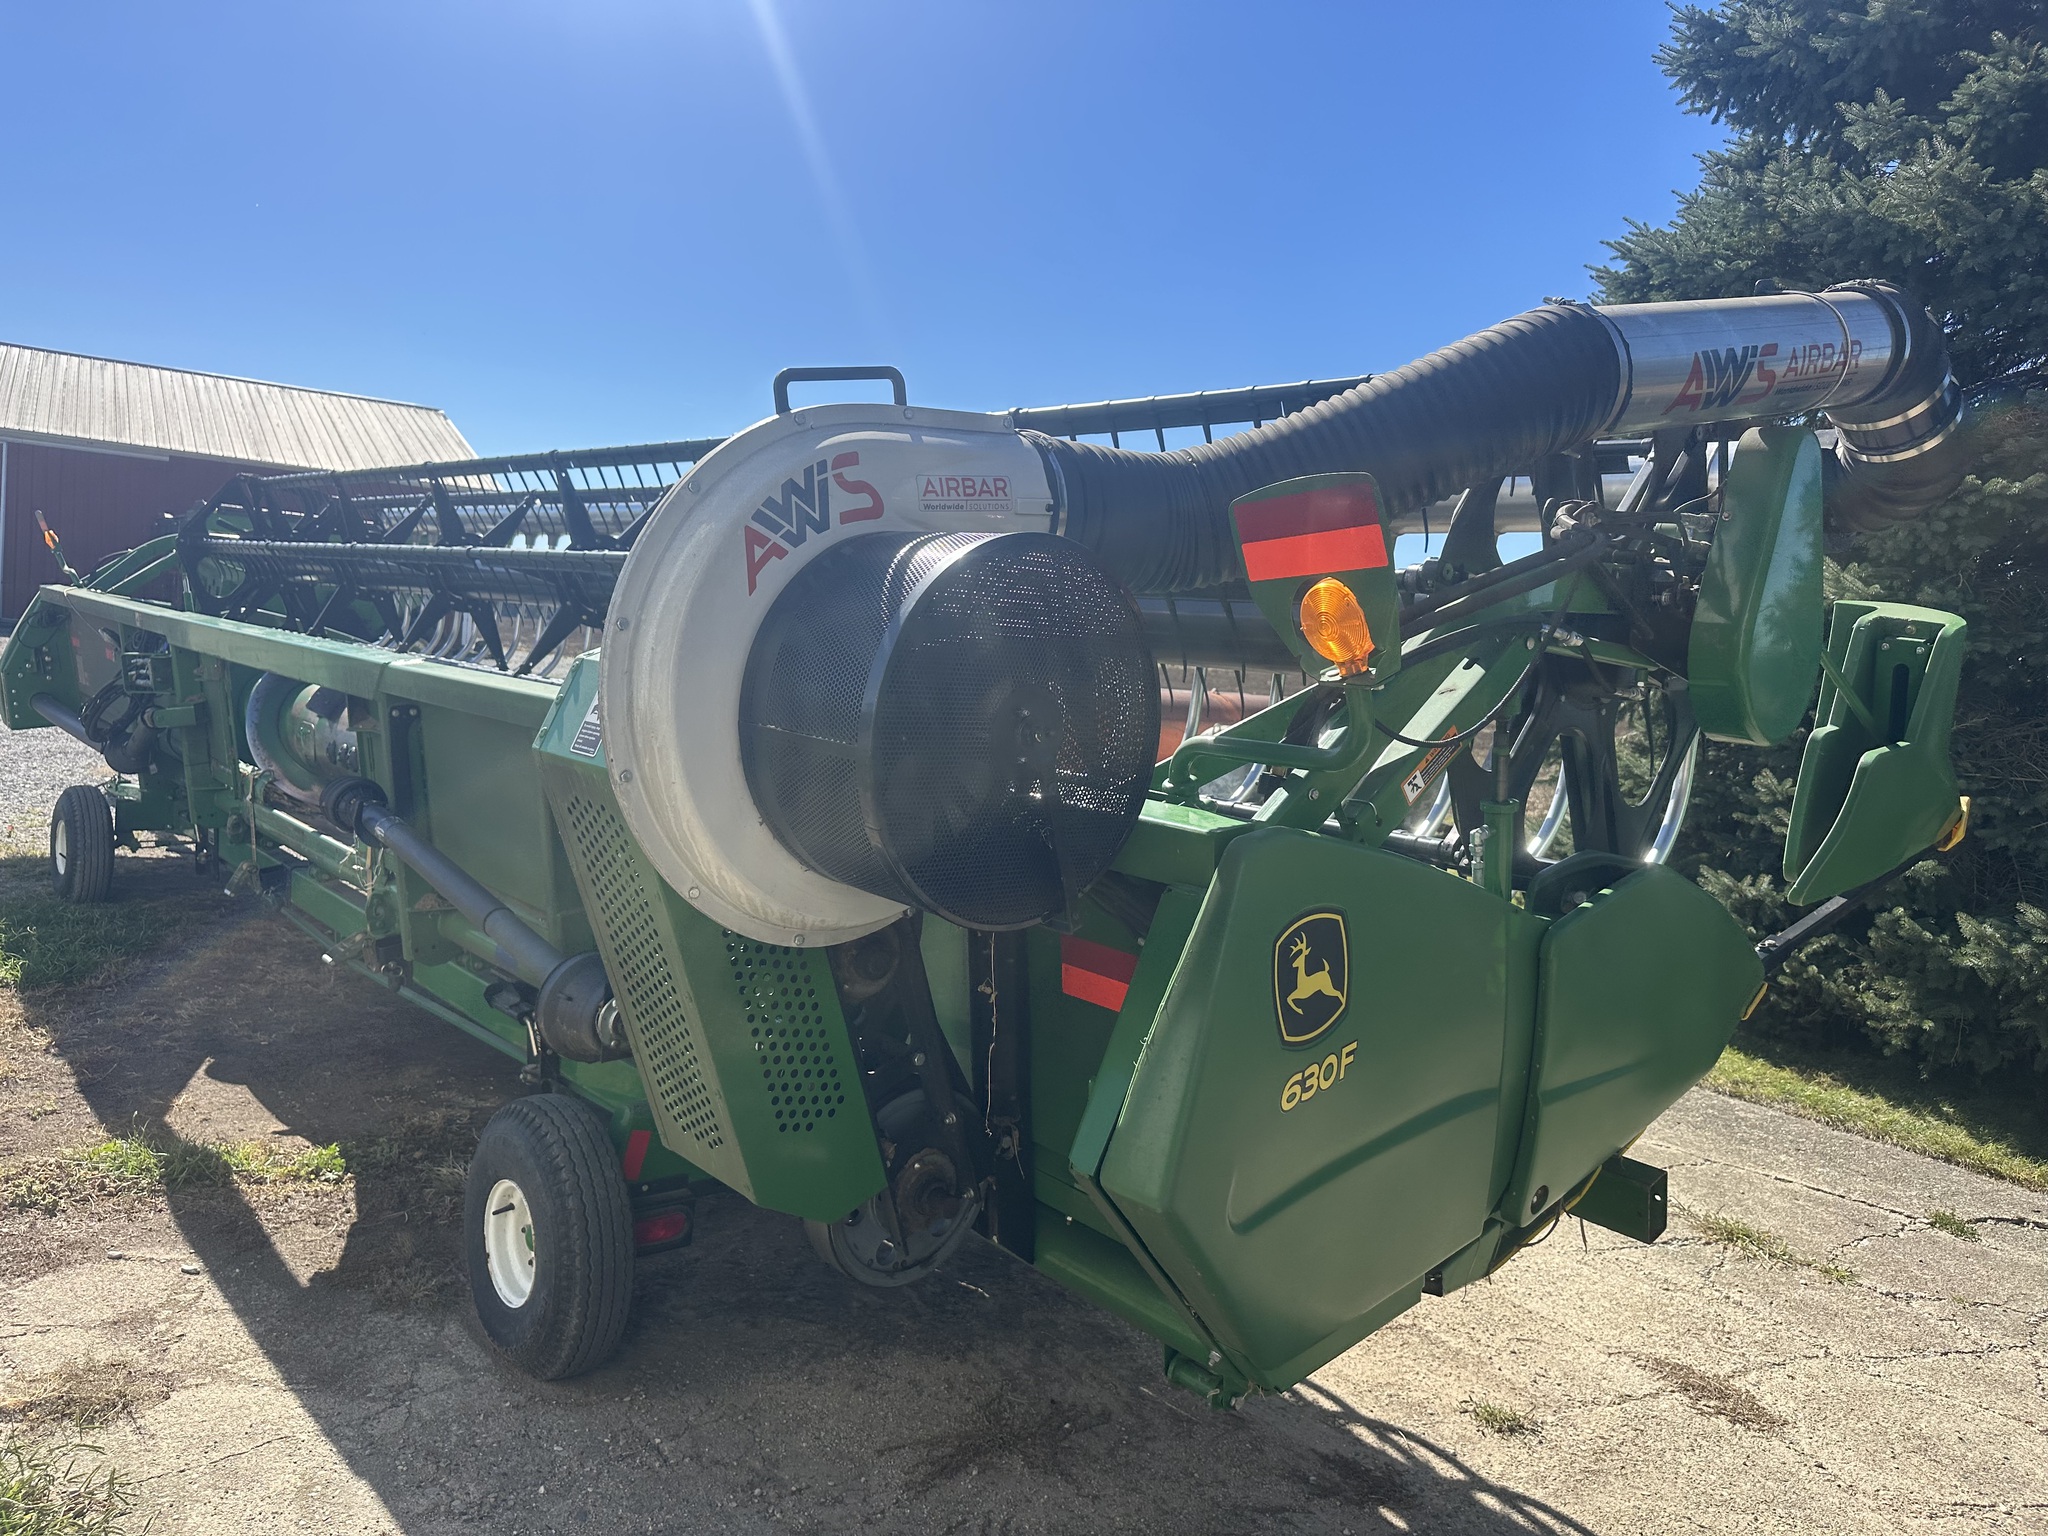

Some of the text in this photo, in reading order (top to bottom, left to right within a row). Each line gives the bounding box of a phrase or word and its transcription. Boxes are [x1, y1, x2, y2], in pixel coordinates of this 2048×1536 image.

[1782, 339, 1863, 379] AIRBAR
[922, 477, 1008, 497] AIRBAR
[923, 503, 1010, 511] Worldwide SOLUTIONS
[1280, 1040, 1358, 1113] 630F
